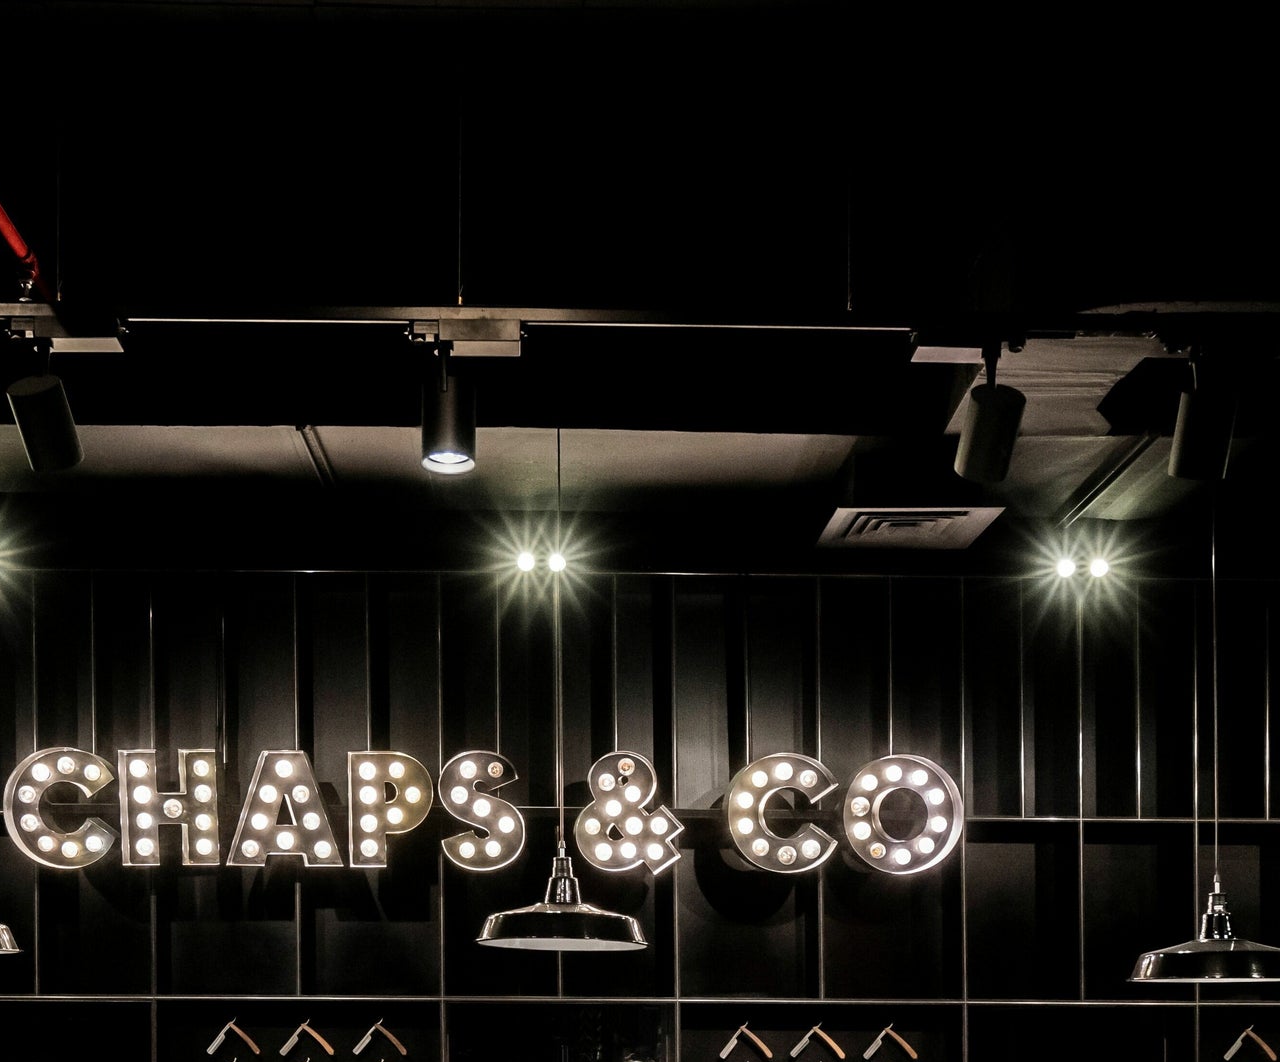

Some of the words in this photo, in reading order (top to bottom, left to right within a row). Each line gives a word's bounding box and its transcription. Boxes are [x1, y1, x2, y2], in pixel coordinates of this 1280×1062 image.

[3, 747, 526, 871] CHAPS
[575, 751, 685, 876] &
[728, 753, 965, 875] CO
